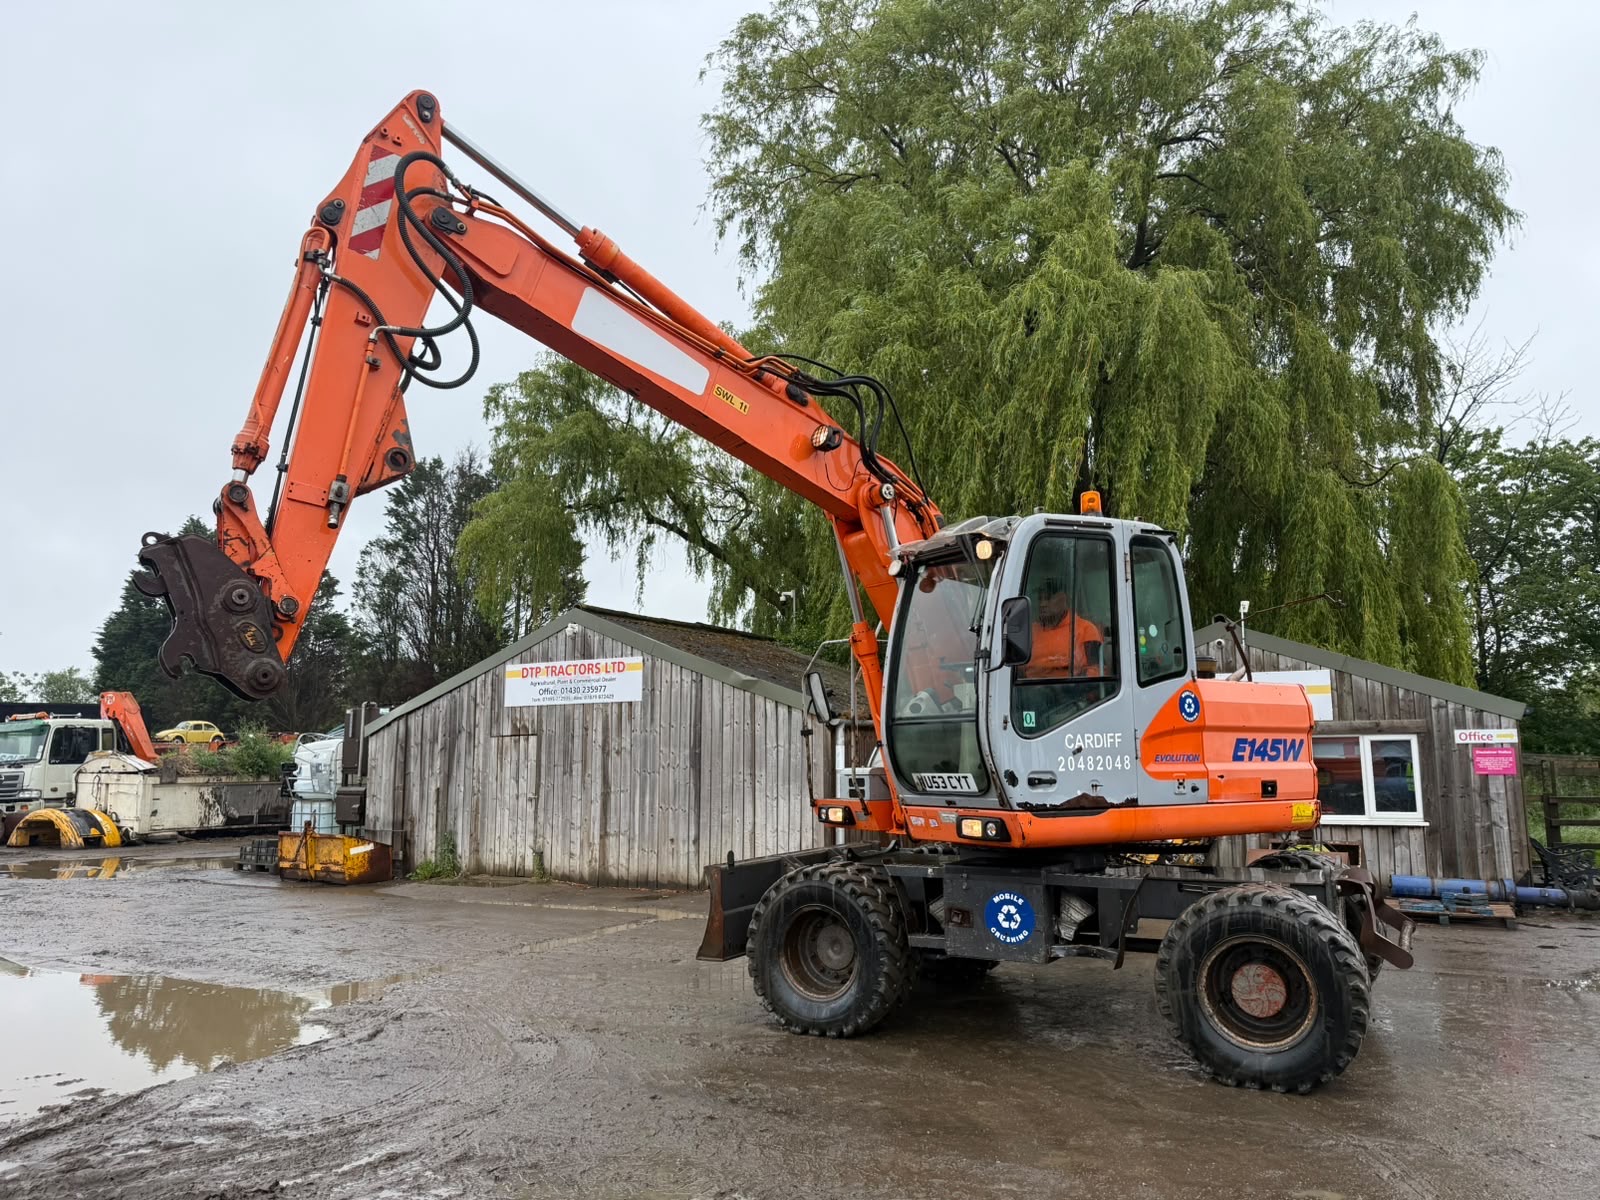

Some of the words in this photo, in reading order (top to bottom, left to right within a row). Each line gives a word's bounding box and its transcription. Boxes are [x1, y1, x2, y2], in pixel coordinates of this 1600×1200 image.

[715, 386, 735, 406] SWL
[521, 666, 541, 678] DTP
[544, 662, 600, 677] TRACTORS
[605, 661, 626, 674] LTD
[560, 686, 580, 694] 01430
[582, 685, 607, 694] 235977
[1064, 732, 1122, 749] CARDIFF
[1458, 731, 1494, 742] Office
[1231, 737, 1305, 762] E145W
[1057, 754, 1131, 772] 20482048
[1154, 753, 1200, 763] EVOLUTION
[946, 775, 972, 790] CYT
[993, 892, 1024, 906] MOBILE
[990, 927, 1029, 943] CRUSHING
